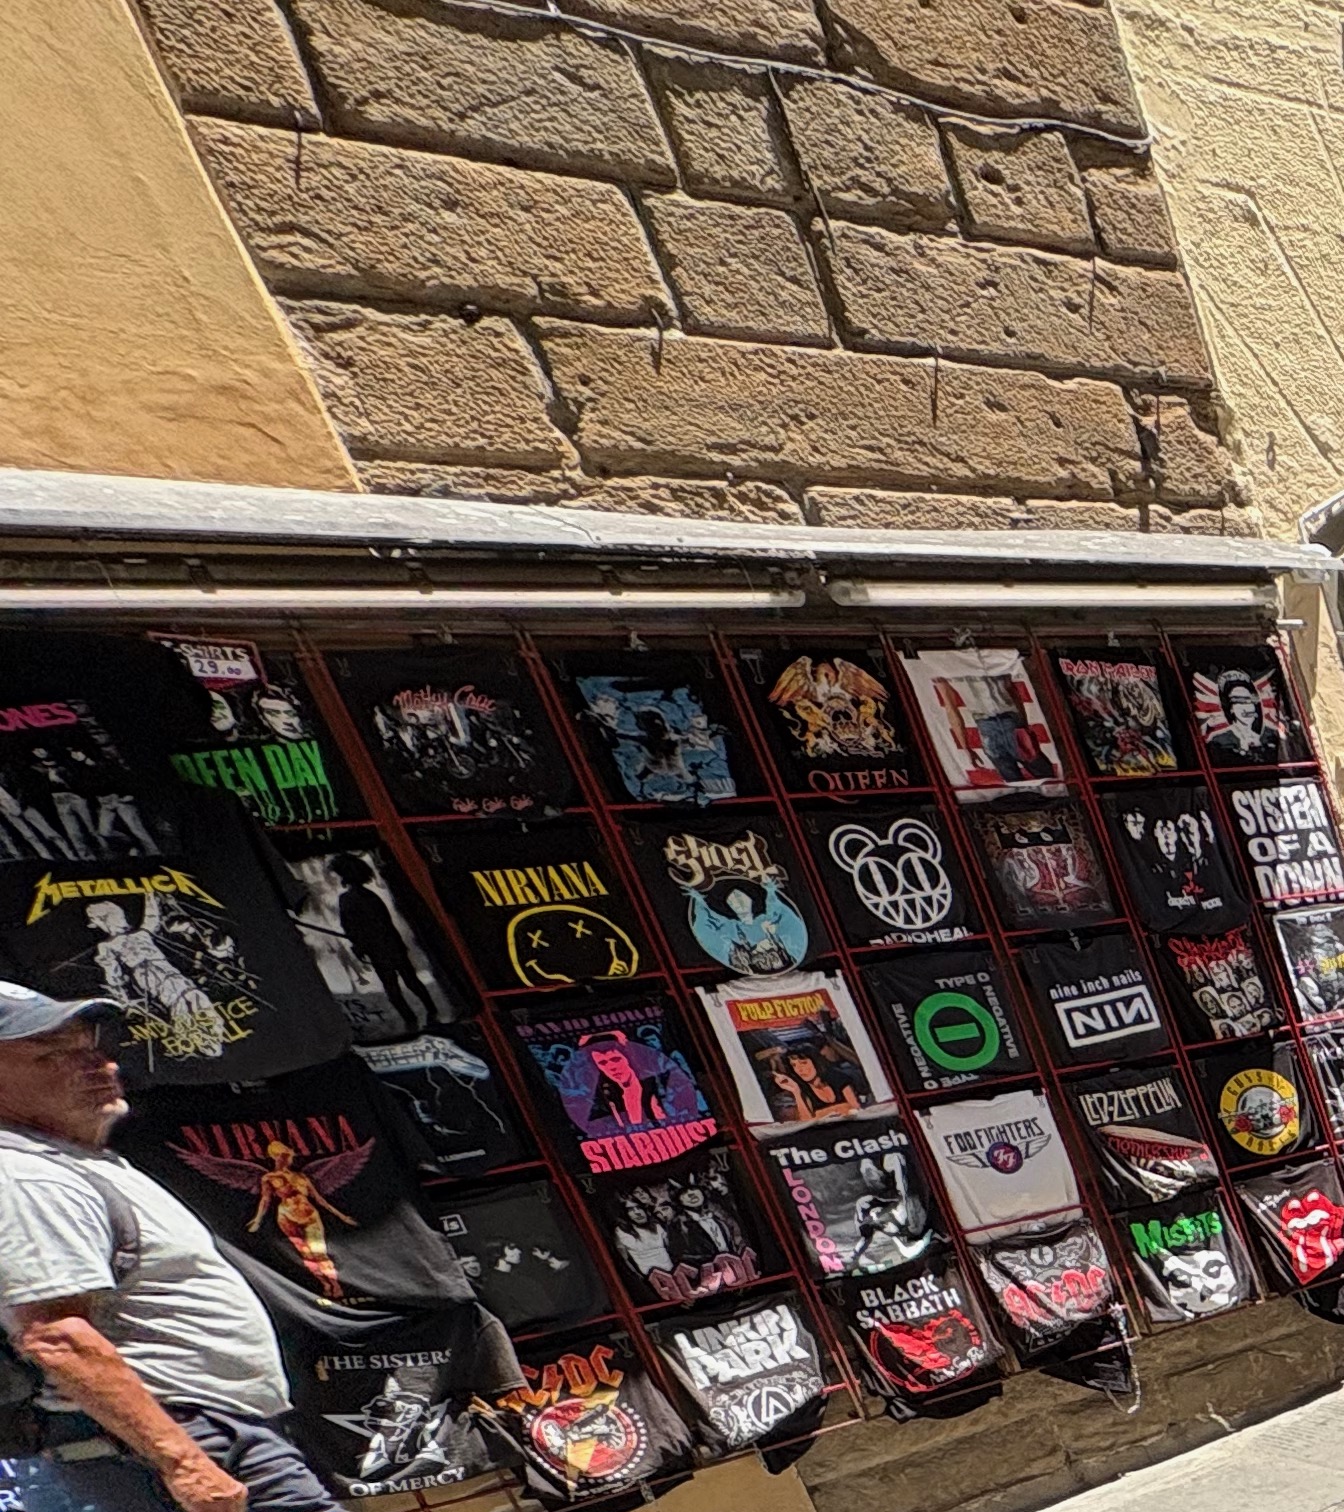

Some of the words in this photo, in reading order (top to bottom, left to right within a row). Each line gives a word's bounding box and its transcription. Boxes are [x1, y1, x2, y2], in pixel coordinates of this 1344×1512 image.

[1231, 783, 1328, 835] SYSTEM
[1248, 834, 1301, 862] OF
[1307, 831, 1337, 858] A
[26, 865, 226, 926] METALLICA
[469, 861, 609, 907] NIRVANA
[935, 975, 975, 990] TYPE
[976, 972, 991, 983] O
[1050, 985, 1079, 1001] nine
[1082, 977, 1110, 994] inch
[1112, 969, 1143, 987] nails
[515, 1015, 591, 1039] DAVID
[738, 997, 774, 1023] PULP
[775, 992, 826, 1018] FICTION
[982, 985, 1020, 1059] NEGATIVE
[1071, 997, 1150, 1036] NIN
[181, 1115, 360, 1160] NIRVANA
[580, 1118, 718, 1175] STARDUST
[769, 1147, 828, 1168] The
[834, 1128, 909, 1159] Clash
[943, 1130, 976, 1155] FOO
[976, 1116, 1046, 1150] FIGHTERS
[781, 1168, 845, 1275] LONDON
[856, 1288, 962, 1330] SABBATH
[860, 1274, 941, 1309] BLACK
[674, 1305, 798, 1360] LINKIN
[320, 1352, 365, 1371] THE
[688, 1331, 810, 1391] PARK
[350, 1481, 383, 1497] OF
[389, 1467, 466, 1495] MERCY
